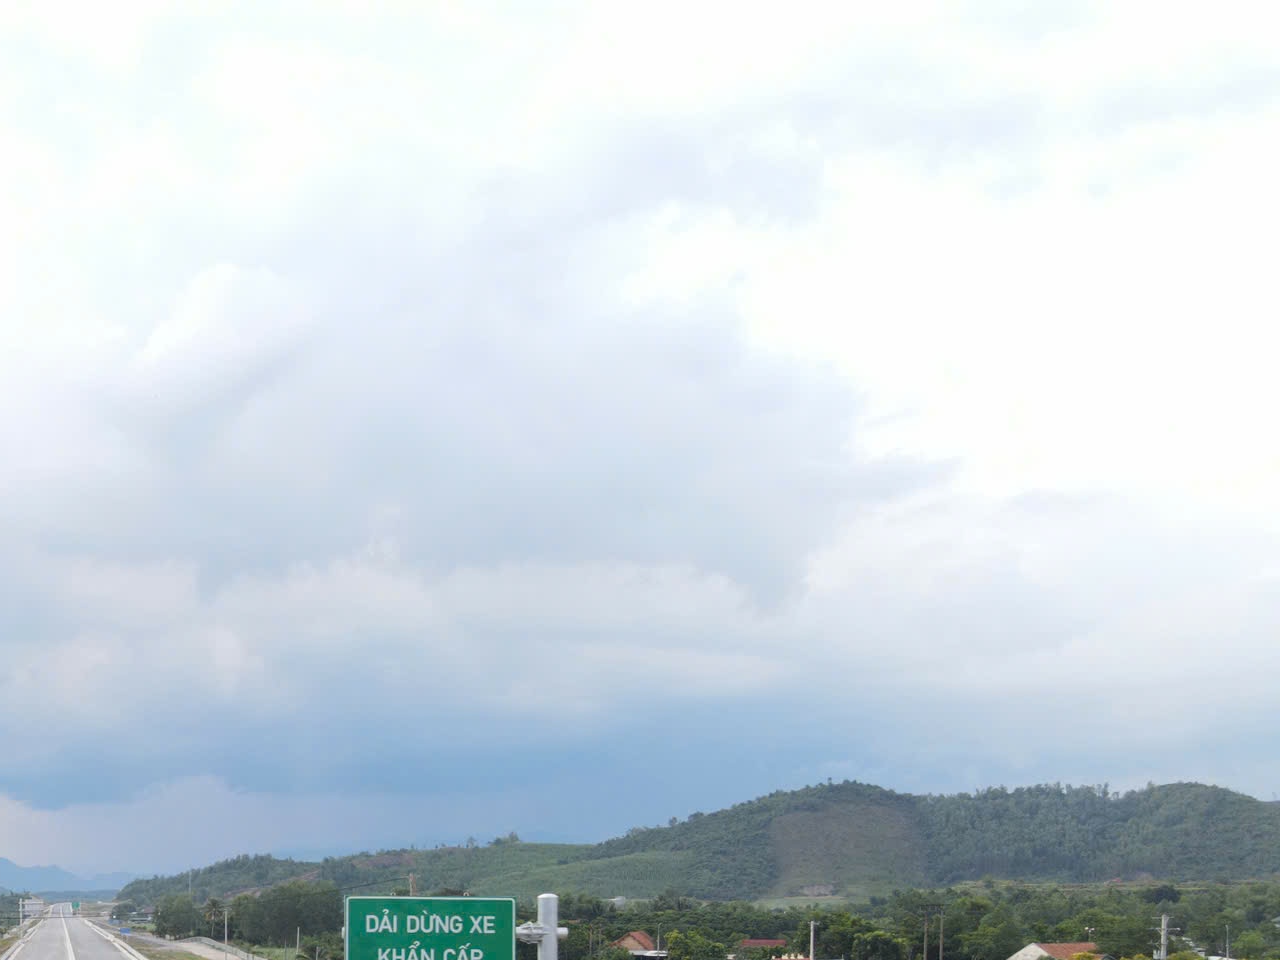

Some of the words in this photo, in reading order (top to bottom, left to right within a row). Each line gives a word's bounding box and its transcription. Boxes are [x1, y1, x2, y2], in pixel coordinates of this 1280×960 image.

[365, 909, 398, 933] DẢI
[406, 910, 463, 934] DỪNG
[469, 916, 496, 934] XE
